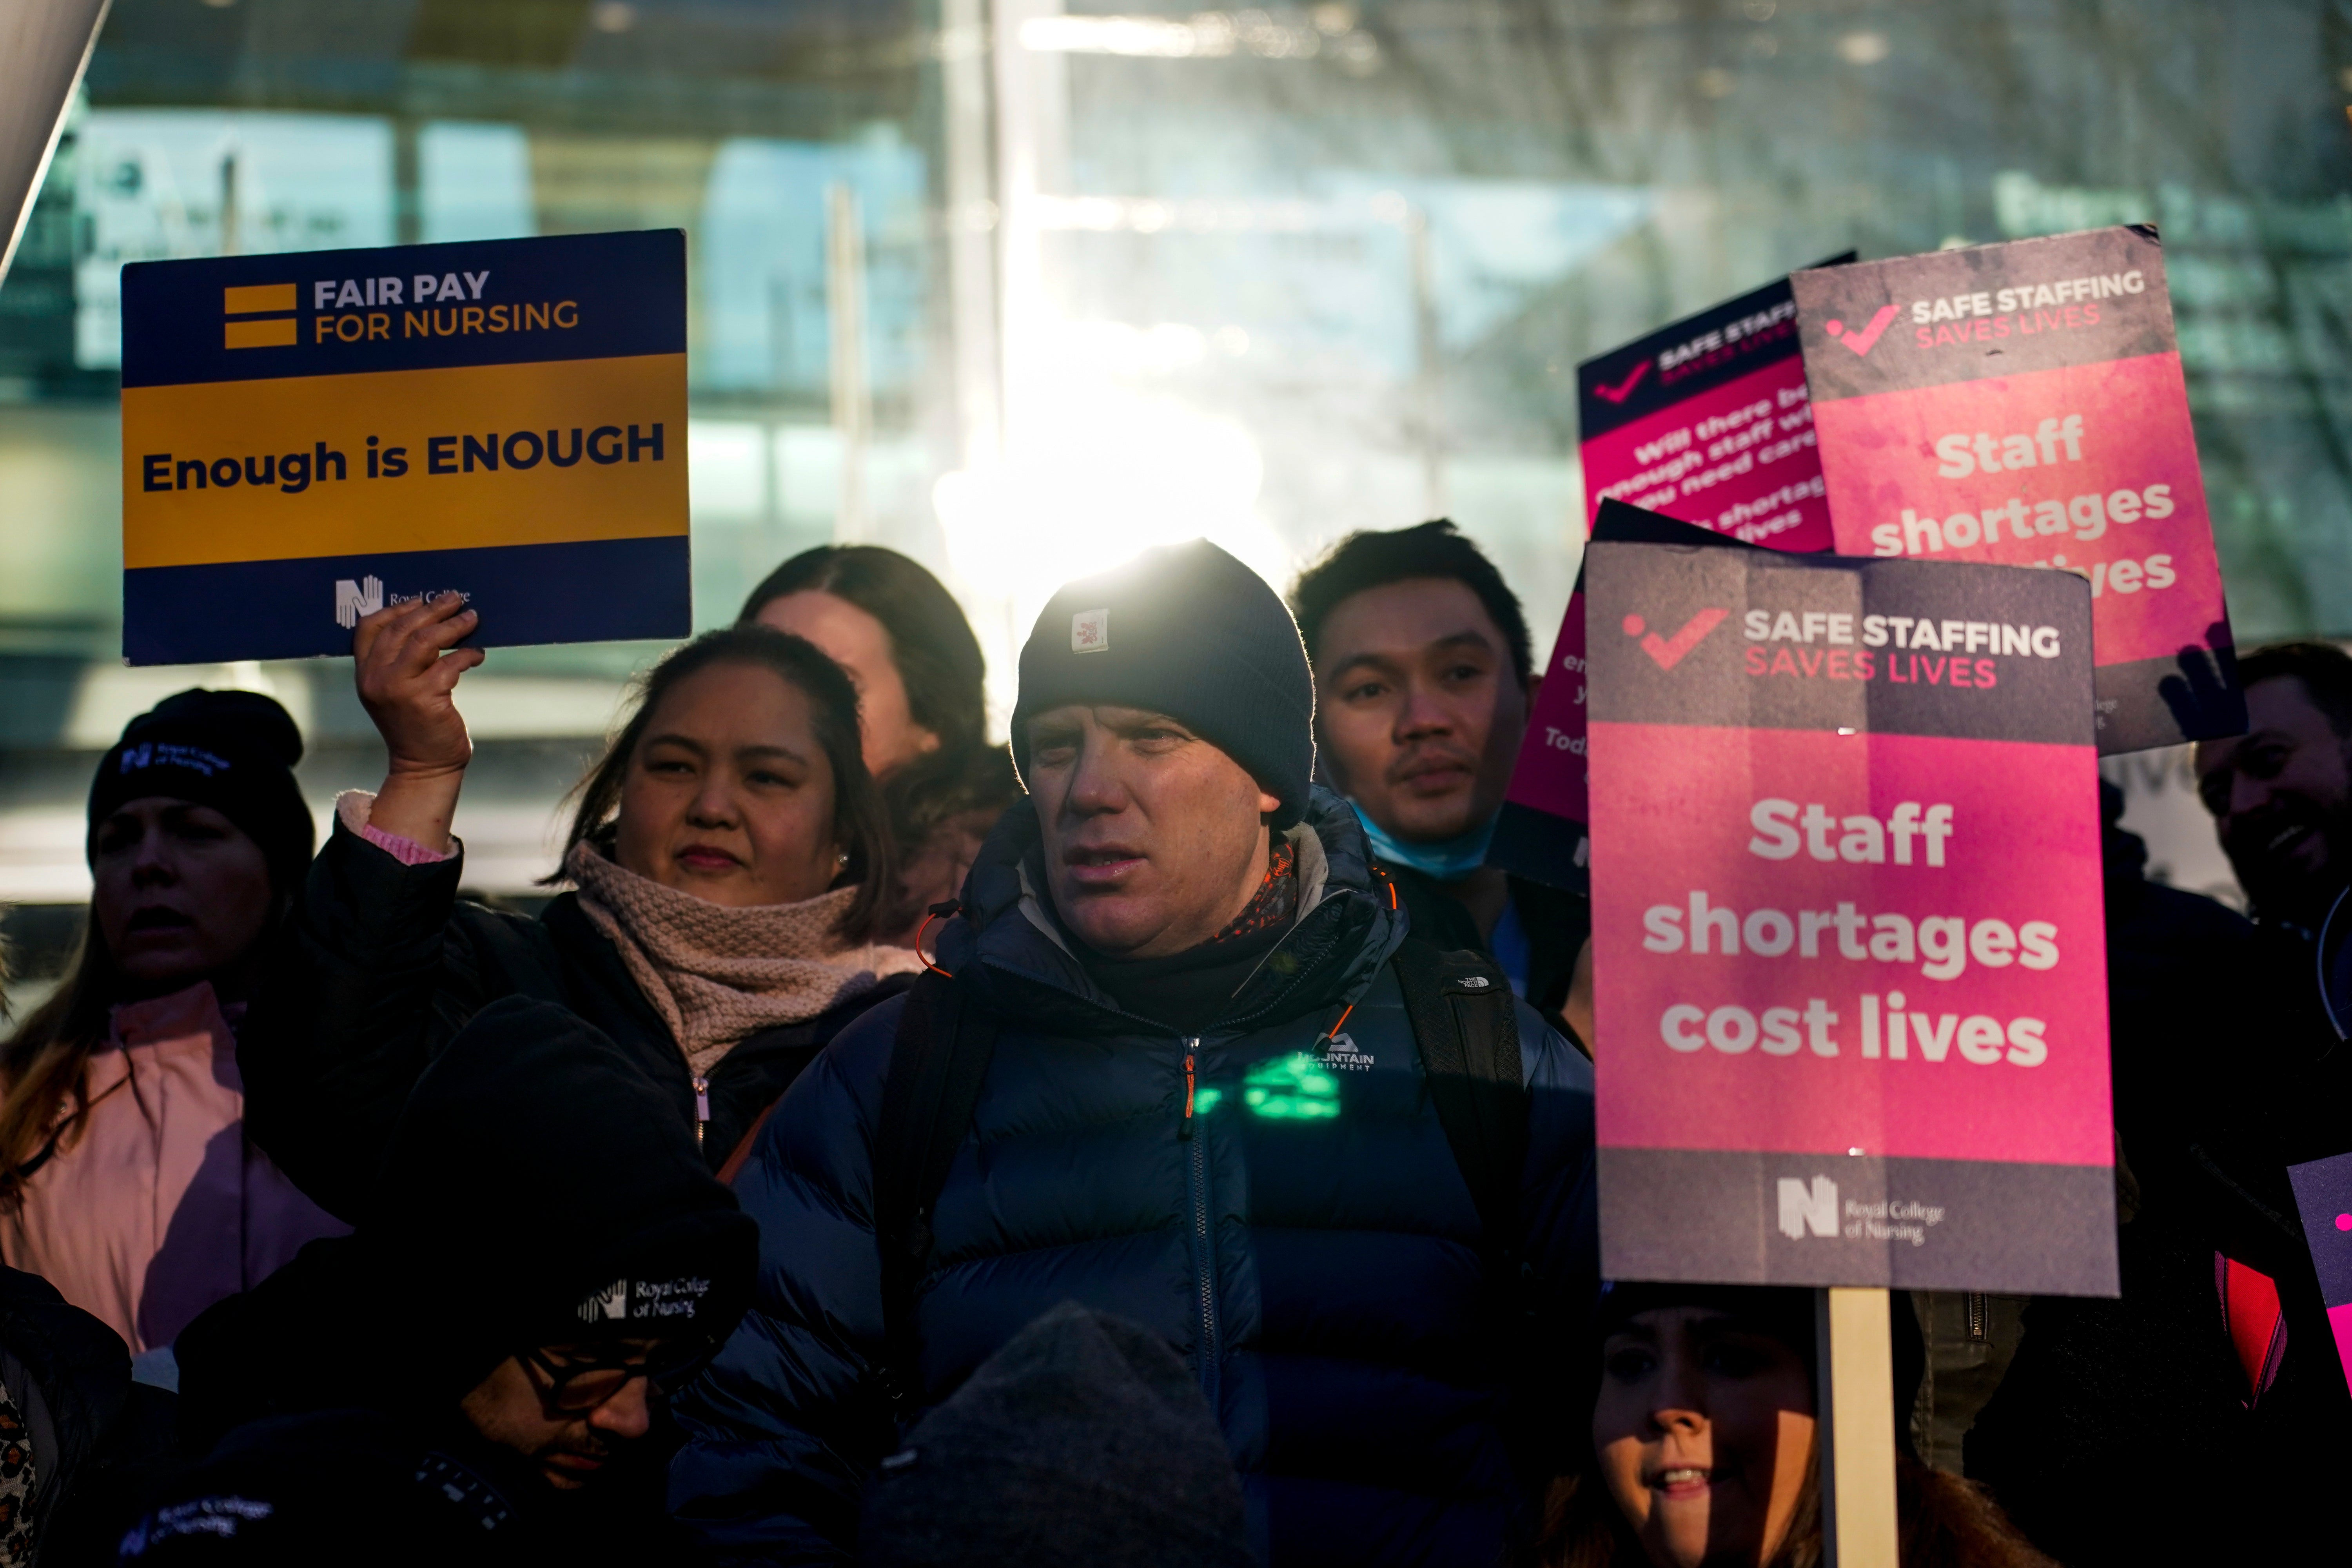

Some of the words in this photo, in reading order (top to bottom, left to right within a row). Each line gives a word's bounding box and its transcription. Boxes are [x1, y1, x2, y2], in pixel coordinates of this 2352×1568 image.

[315, 277, 403, 309] FAIR
[414, 271, 490, 303] PAY
[1911, 292, 1993, 324] SAFE
[1997, 270, 2145, 312] STAFFING
[316, 313, 390, 343] FOR
[405, 300, 579, 338] NURSING
[1916, 316, 2011, 348] SAVES
[2019, 304, 2101, 335] LIVES
[1659, 329, 1722, 371] SAFE
[1633, 426, 1692, 465] Will
[1695, 399, 1773, 441] there
[1707, 417, 1773, 461] staff
[1935, 415, 2084, 479] Staff
[143, 442, 346, 494] Enough
[366, 435, 408, 478] is
[428, 423, 664, 475] ENOUGH
[1681, 450, 1753, 496] need
[1871, 484, 2174, 557] shortages
[2034, 554, 2176, 599] ves
[1744, 609, 1854, 645] SAFE
[1862, 615, 2060, 659] STAFFING
[1745, 646, 1875, 680] SAVES
[1889, 653, 1997, 689] LIVES
[1748, 798, 1953, 867] Staff
[1643, 890, 2059, 980] shortages
[1660, 998, 1839, 1058] cost
[1860, 991, 2047, 1067] lives
[1845, 1199, 1887, 1221] Royal
[1889, 1200, 1945, 1227] College
[1845, 1219, 1862, 1238] of
[1866, 1220, 1925, 1247] Nursing
